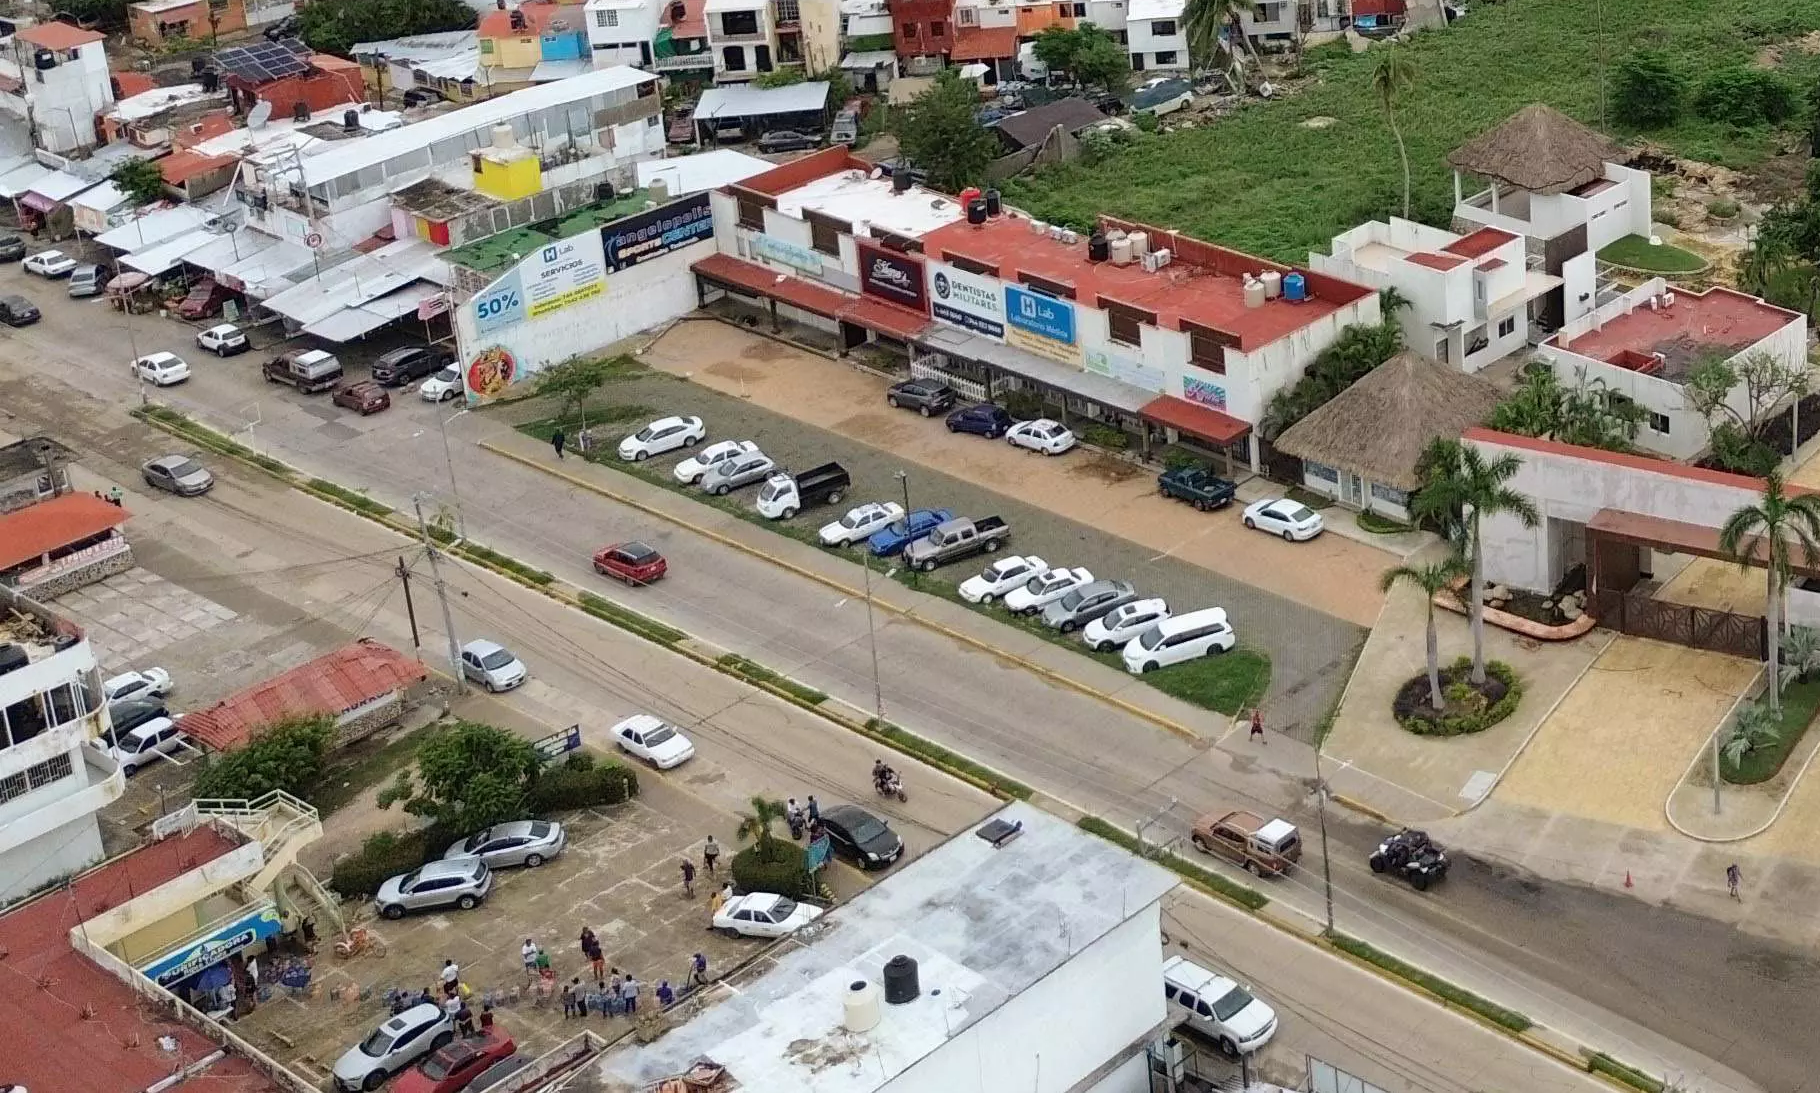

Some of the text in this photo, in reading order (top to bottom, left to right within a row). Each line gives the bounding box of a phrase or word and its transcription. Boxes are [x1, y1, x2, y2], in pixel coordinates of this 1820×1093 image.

[541, 258, 583, 279] SERVICIOS
[951, 280, 997, 302] DENTISTAS
[477, 291, 518, 319] 50%
[953, 293, 998, 312] MILITARES
[1038, 306, 1055, 319] Lab
